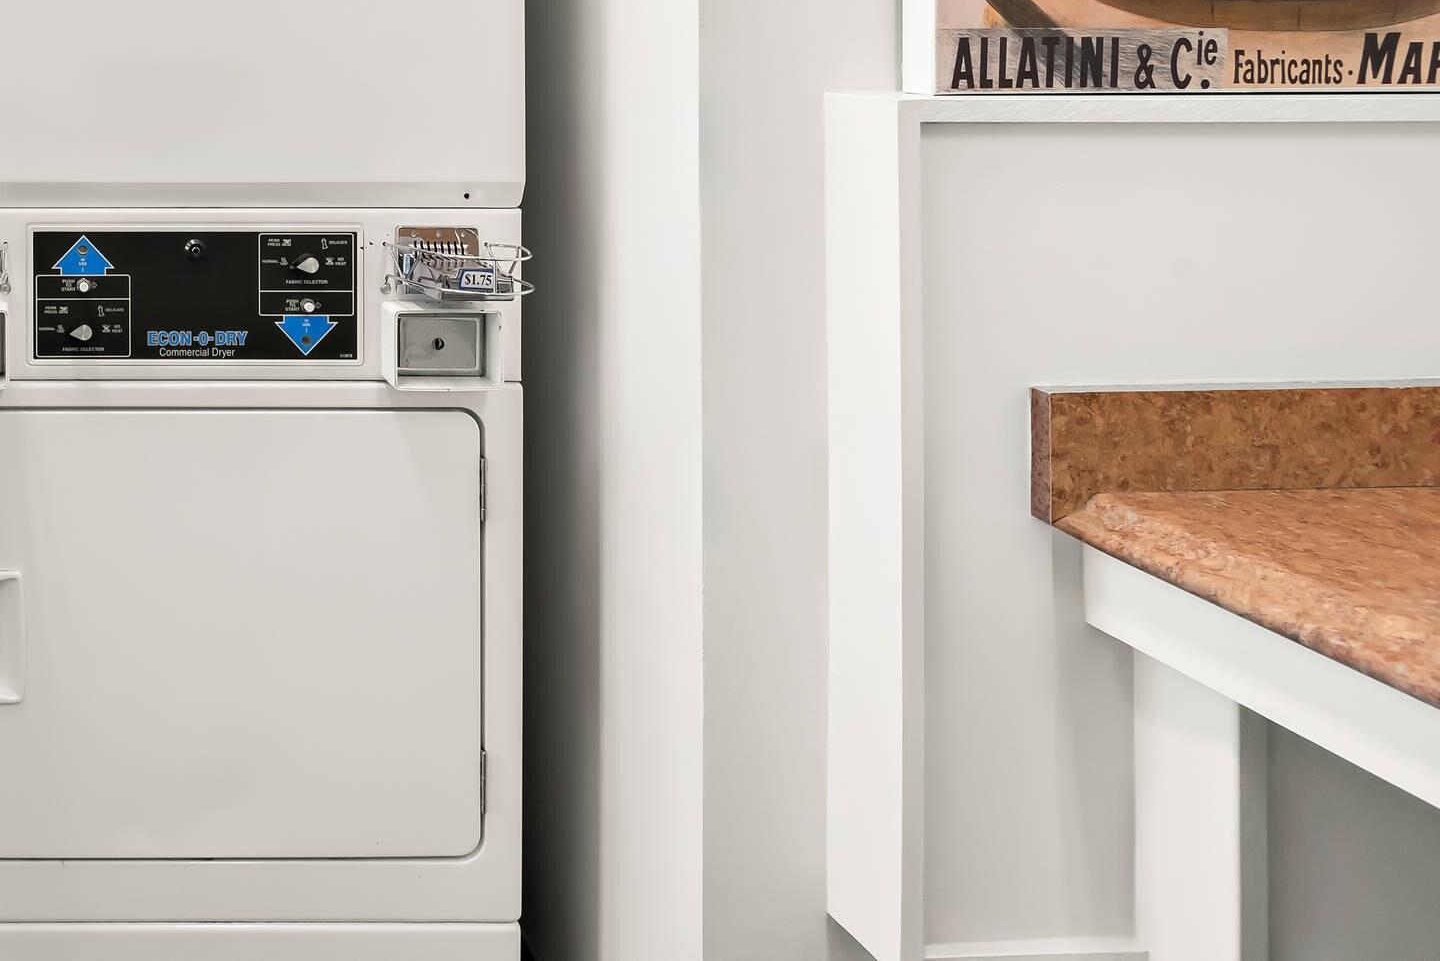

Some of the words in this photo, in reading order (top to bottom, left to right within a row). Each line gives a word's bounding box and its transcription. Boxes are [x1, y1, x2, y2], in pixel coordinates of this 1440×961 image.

[951, 37, 1120, 88] ALLATINI
[1134, 43, 1157, 89] &
[1233, 49, 1344, 85] Fabricants
[464, 273, 492, 286] $1.75
[159, 347, 210, 357] Commercial
[211, 348, 236, 358] Dryer
